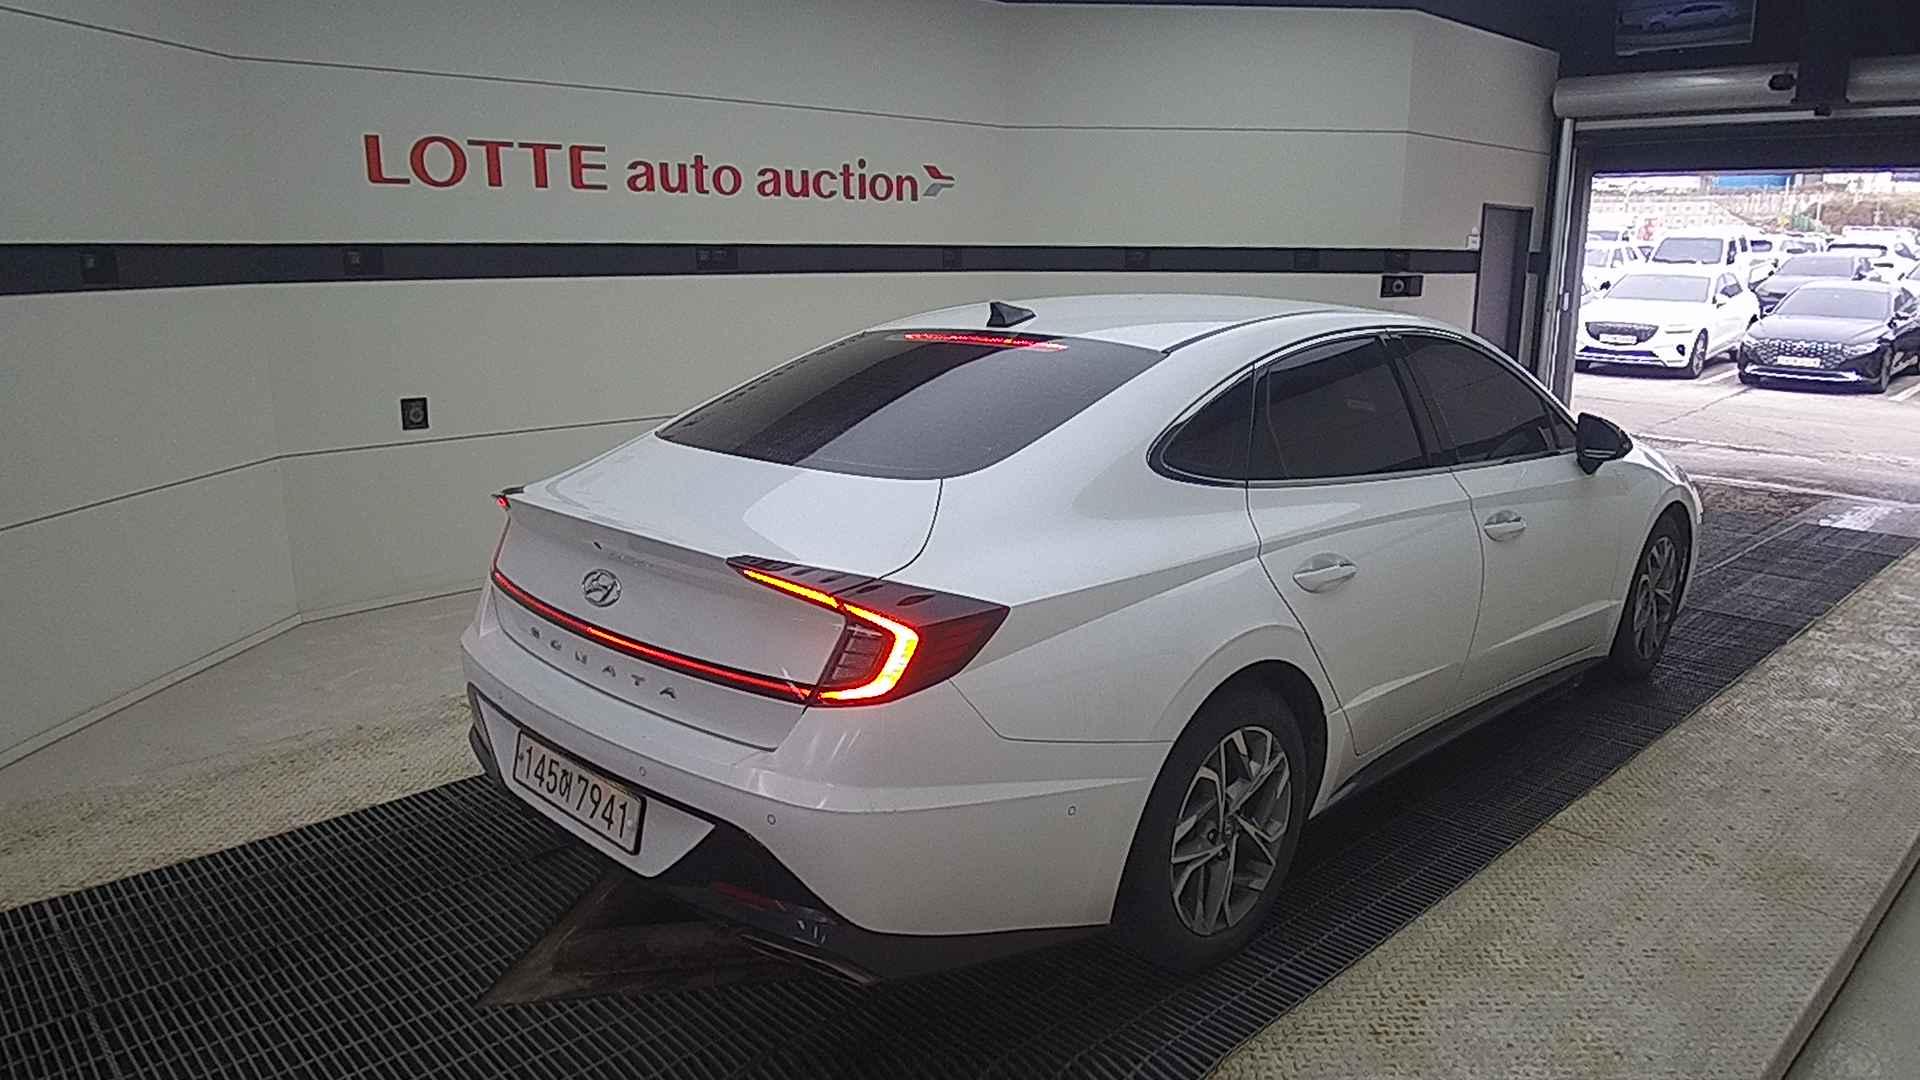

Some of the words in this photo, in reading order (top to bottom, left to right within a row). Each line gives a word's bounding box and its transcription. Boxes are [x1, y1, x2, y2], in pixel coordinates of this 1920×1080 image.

[364, 134, 608, 190] LOTTE
[626, 155, 742, 196] auto
[757, 158, 919, 202] auction
